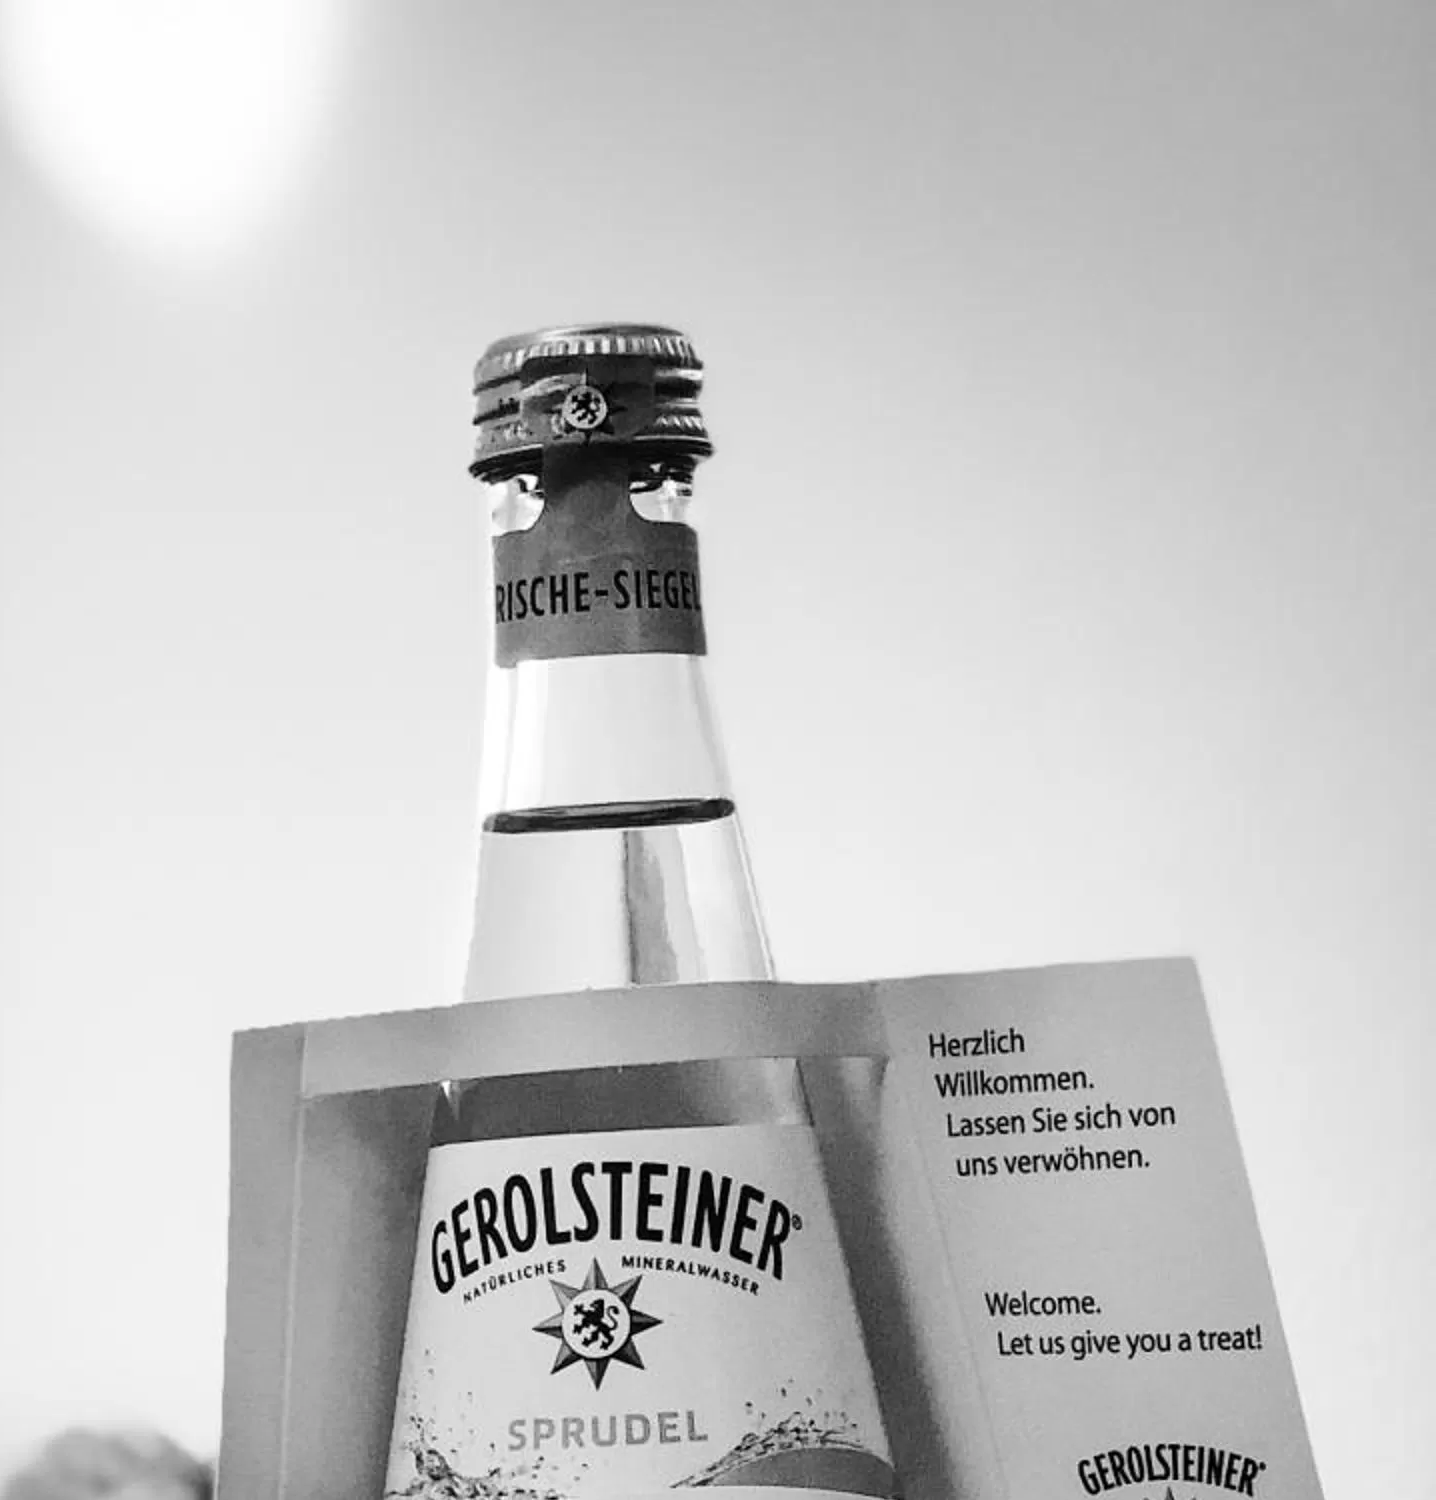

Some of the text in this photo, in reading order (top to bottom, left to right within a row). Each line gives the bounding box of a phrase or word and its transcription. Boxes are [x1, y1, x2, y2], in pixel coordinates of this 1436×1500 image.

[928, 1028, 1025, 1058] Herzlich
[935, 1070, 1095, 1098] Willkommen.
[947, 1102, 1176, 1137] Lassen Sie sich von
[955, 1145, 1150, 1177] uns verwöhnen.
[431, 1161, 784, 1294] GEROLSTEINER
[463, 1254, 760, 1303] NATÜRLICHES MINERALWASSER
[984, 1290, 1101, 1316] Welcome.
[997, 1324, 1263, 1360] Let us give you a treat!
[507, 1409, 709, 1452] SPRUDEL
[1077, 1442, 1255, 1498] GEROLSTEINER
